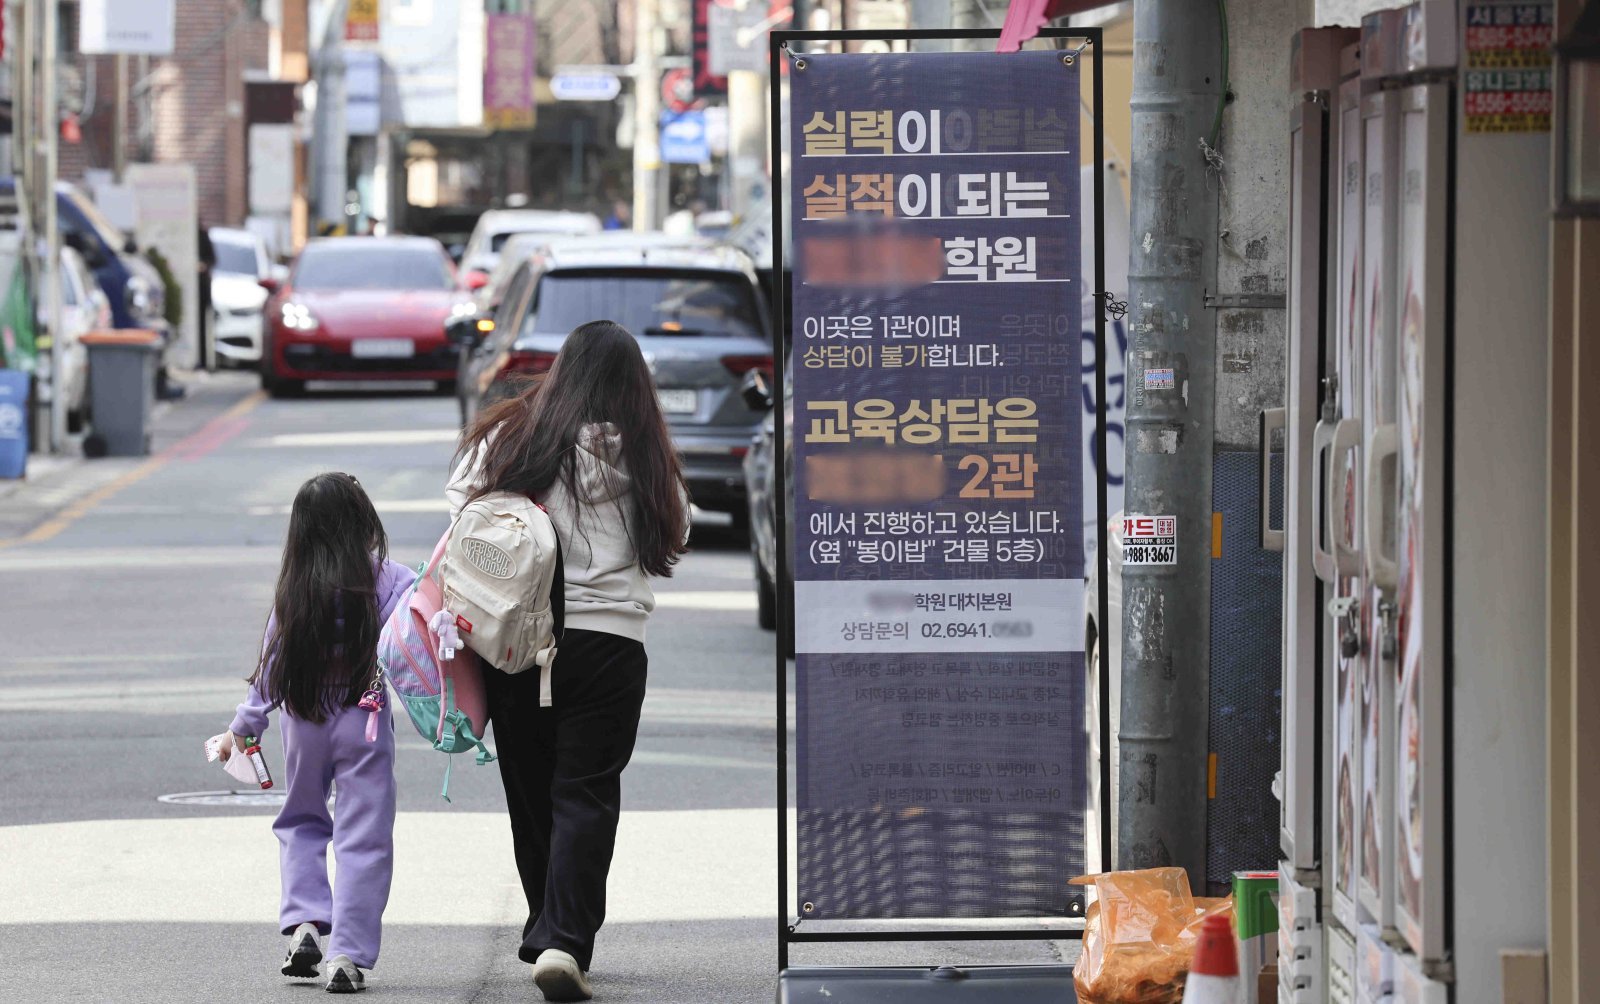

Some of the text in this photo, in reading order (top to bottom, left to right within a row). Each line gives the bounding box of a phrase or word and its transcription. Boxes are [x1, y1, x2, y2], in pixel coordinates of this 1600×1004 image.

[803, 109, 940, 154] 실력이
[803, 171, 1050, 218] 실적이 되는
[803, 315, 961, 339] 이곳은 1관이며
[803, 344, 1004, 368] 상담이 불가합니다.
[805, 397, 1039, 444] 교육상담은
[957, 453, 1039, 499] 2관
[809, 510, 1065, 535] 에서 진행하고 있습니다.
[809, 539, 841, 564] (옆
[848, 540, 936, 563] "봉이밥"
[943, 539, 989, 562] 건물
[995, 538, 1045, 563] 5층)
[840, 622, 909, 641] 상담문의
